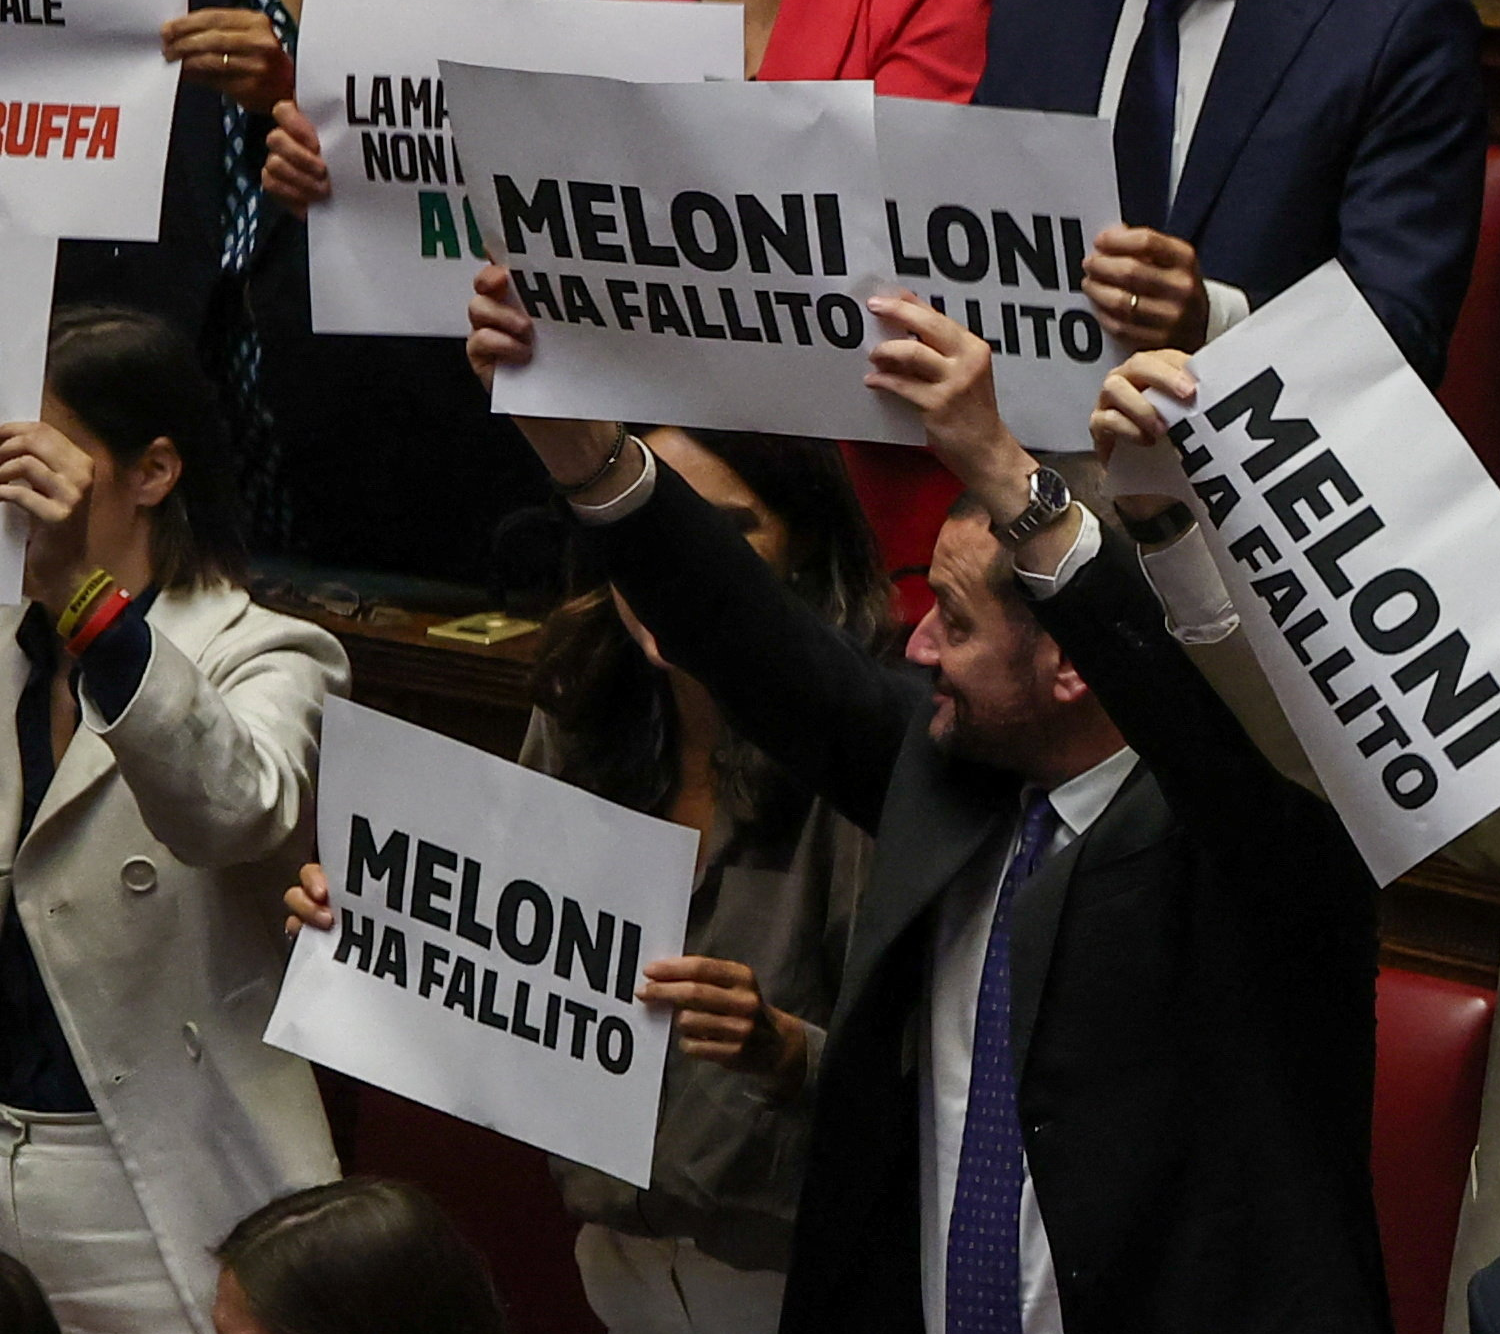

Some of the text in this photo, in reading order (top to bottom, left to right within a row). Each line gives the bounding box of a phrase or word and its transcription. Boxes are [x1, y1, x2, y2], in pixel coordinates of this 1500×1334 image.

[0, 100, 120, 160] UFFA
[346, 74, 396, 128] LA
[361, 131, 448, 186] NON
[418, 190, 462, 260] A
[492, 173, 846, 275] MELONI
[885, 198, 1086, 294] LONI
[513, 269, 864, 350] HA FALLITO
[930, 294, 1103, 363] LITO
[1167, 421, 1440, 811] HA FALLITO
[345, 816, 642, 1005] MELONI
[333, 906, 635, 1075] HA FALLITO
